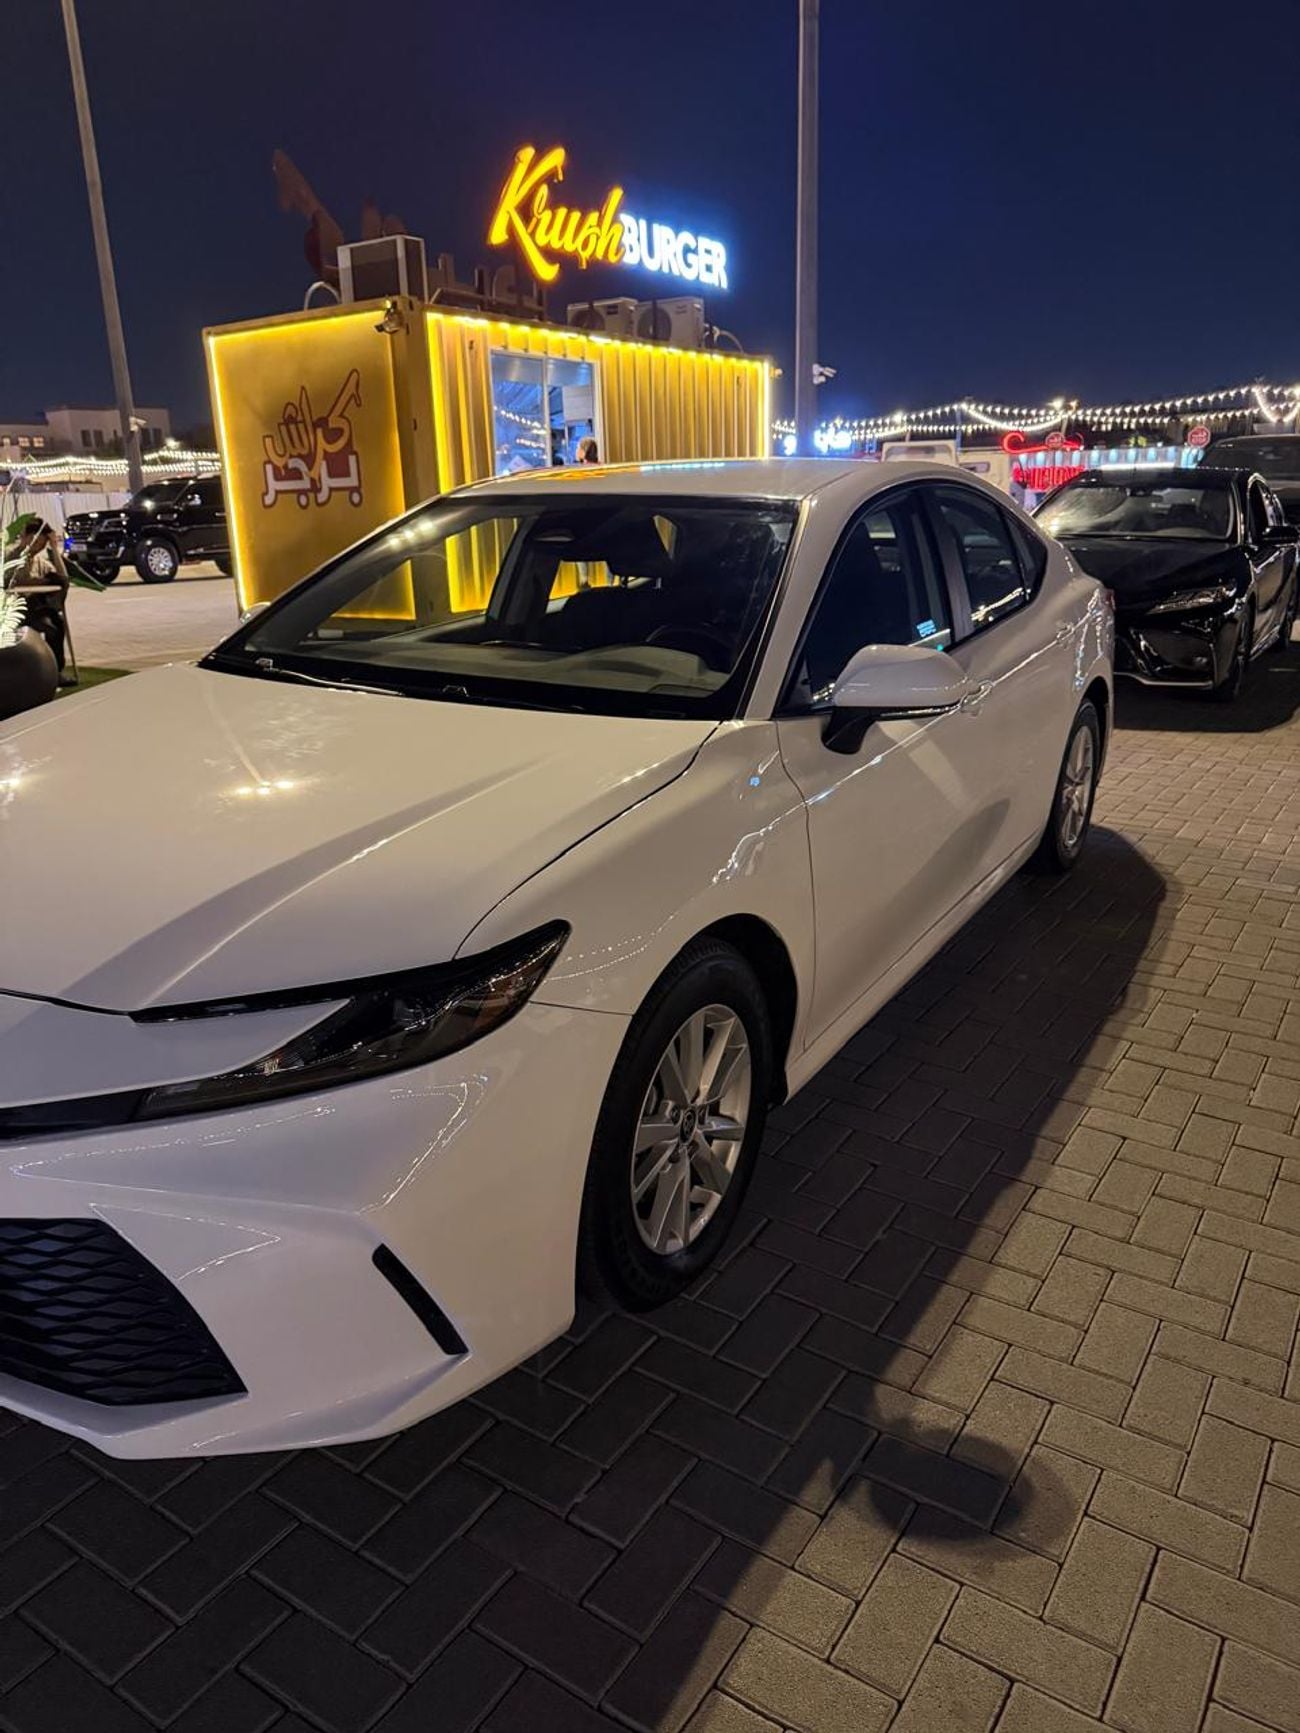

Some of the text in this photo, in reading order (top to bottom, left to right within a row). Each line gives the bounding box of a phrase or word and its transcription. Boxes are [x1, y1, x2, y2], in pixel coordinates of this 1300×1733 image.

[488, 146, 626, 282] Krush
[620, 213, 729, 289] BURGER
[262, 452, 362, 509] برجر
[263, 368, 362, 488] كراش
